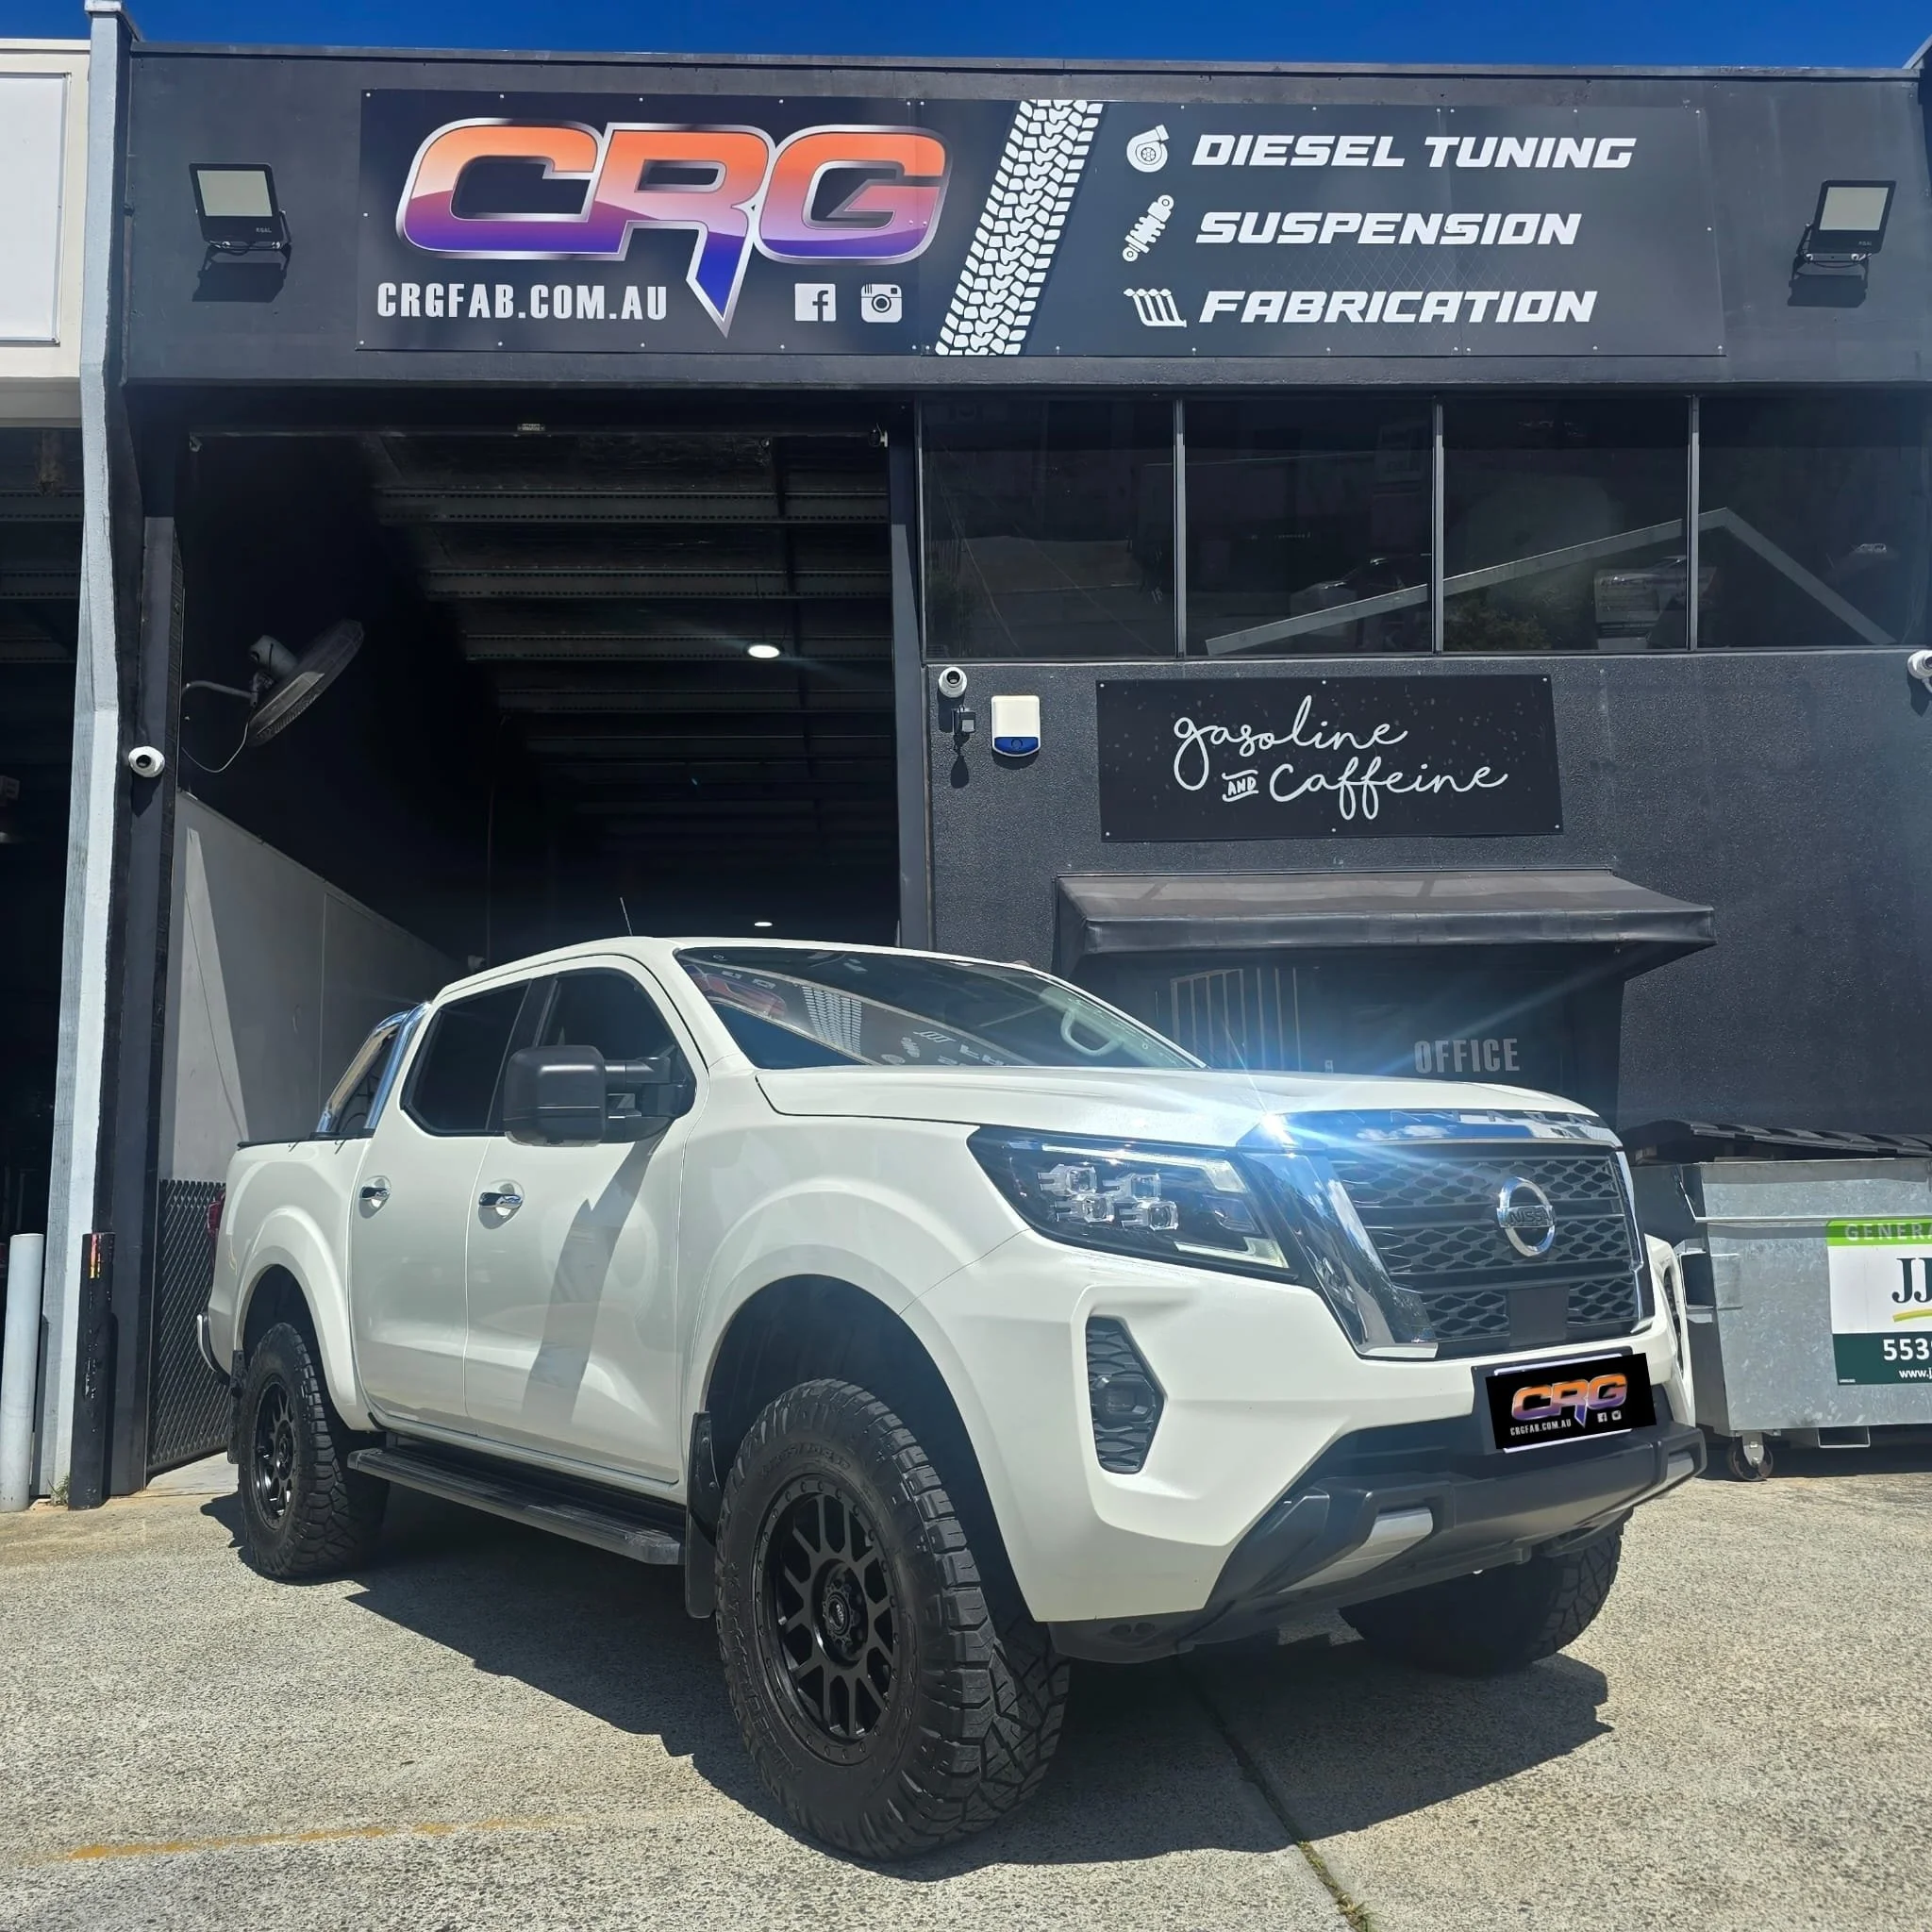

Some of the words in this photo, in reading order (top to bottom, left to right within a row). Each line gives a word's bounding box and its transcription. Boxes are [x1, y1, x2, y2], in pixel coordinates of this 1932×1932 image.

[1192, 134, 1406, 167] DIESEL
[1424, 136, 1637, 168] TUNING
[395, 117, 949, 338] CRG
[1195, 211, 1582, 245] SUSPENSION
[376, 282, 668, 321] CRGFAB.COM.AU
[1198, 290, 1598, 324] FABRICATION
[1174, 695, 1408, 791] gasoline
[1414, 1038, 1521, 1074] OFFICE
[1883, 1337, 1932, 1361] 553
